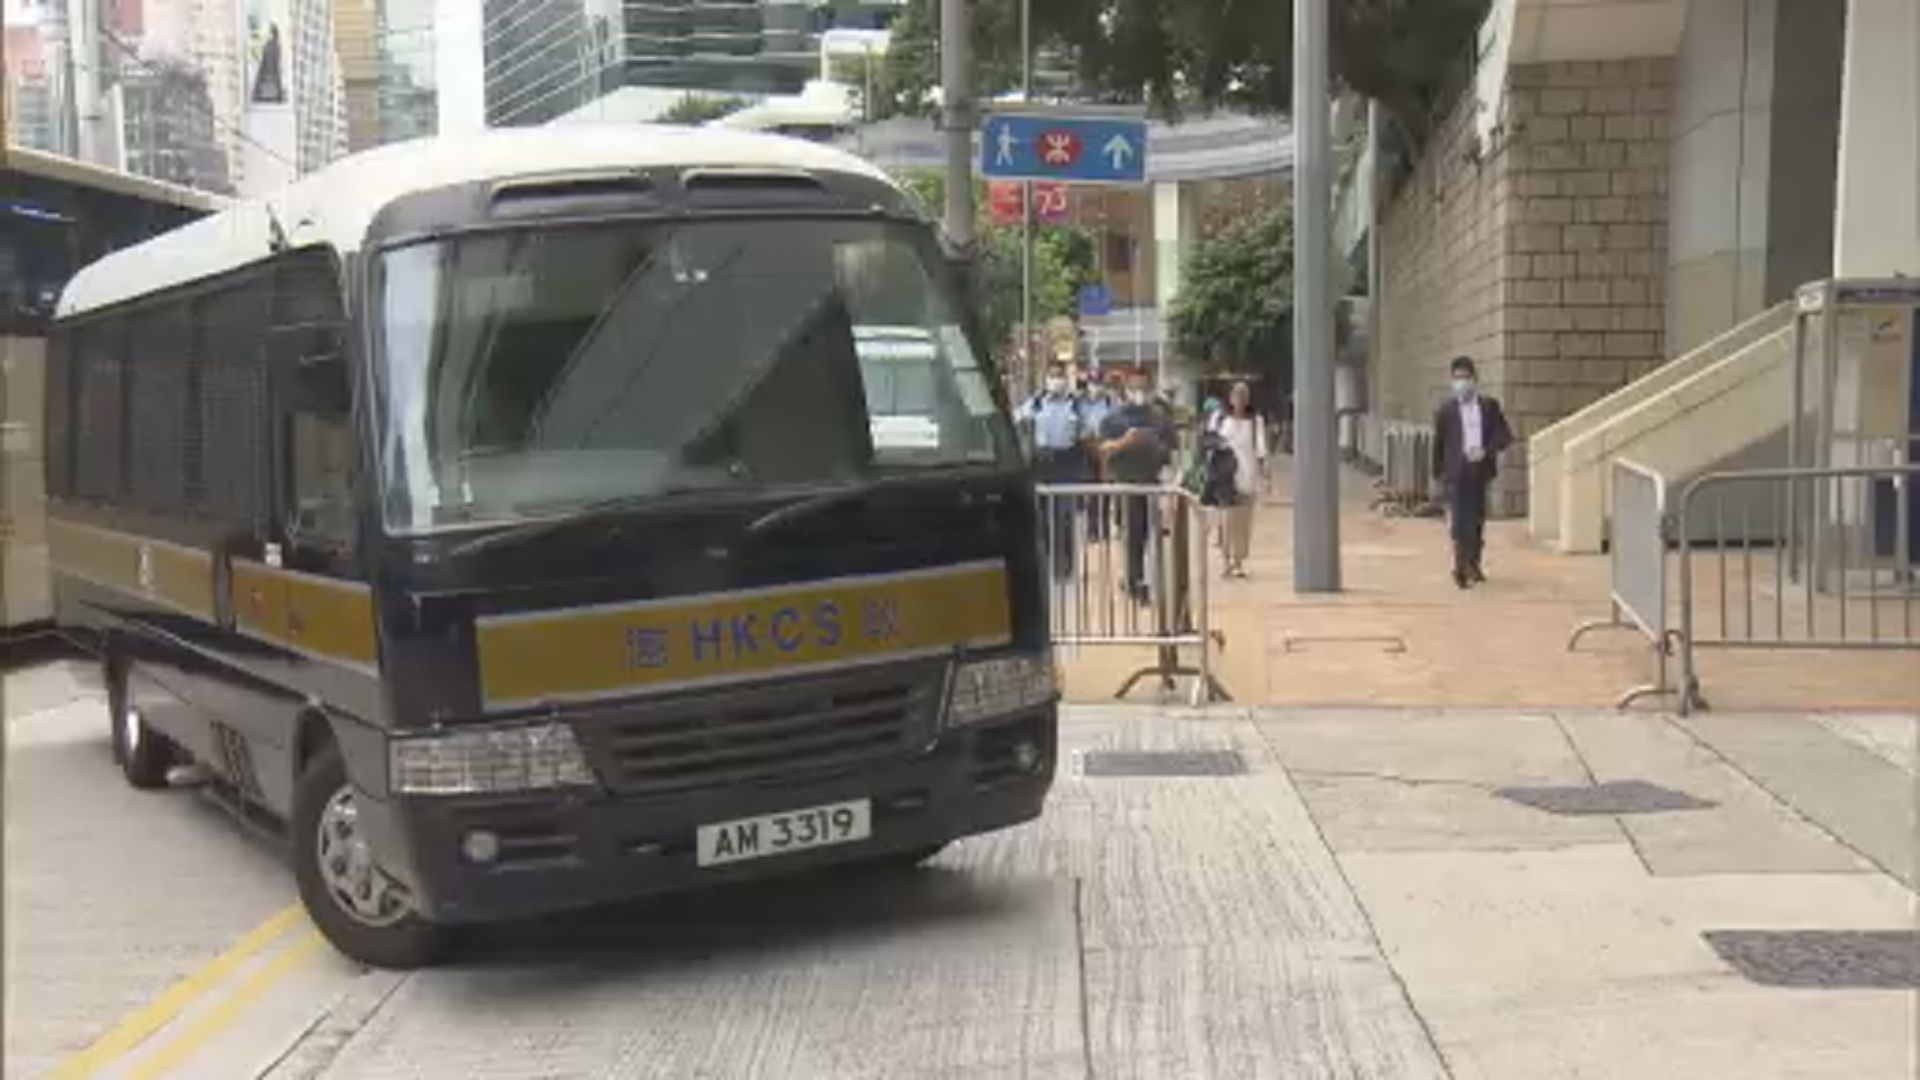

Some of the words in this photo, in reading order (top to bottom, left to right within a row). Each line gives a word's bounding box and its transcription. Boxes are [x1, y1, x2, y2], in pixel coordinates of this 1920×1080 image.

[691, 600, 843, 661] HKCS
[713, 823, 759, 858] AM
[771, 807, 853, 847] 3319
